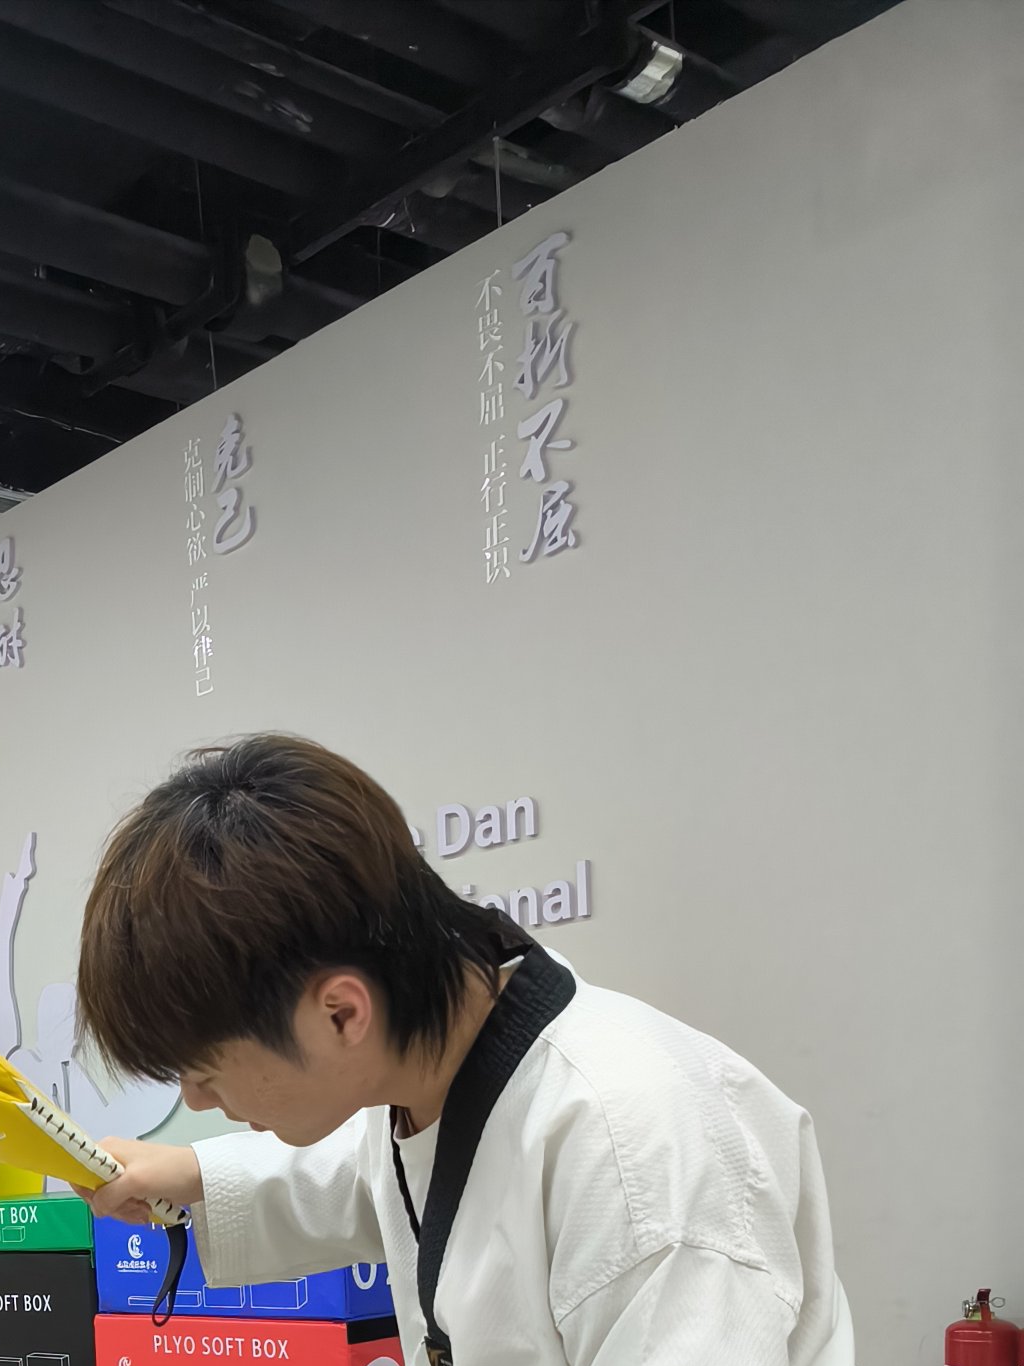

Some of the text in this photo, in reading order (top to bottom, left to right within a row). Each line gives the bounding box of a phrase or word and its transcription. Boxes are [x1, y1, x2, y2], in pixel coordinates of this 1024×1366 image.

[436, 795, 539, 858] Dan
[10, 1205, 38, 1224] BOX
[23, 1294, 52, 1312] BOX
[153, 1334, 290, 1360] PLYO SOFT BOX
